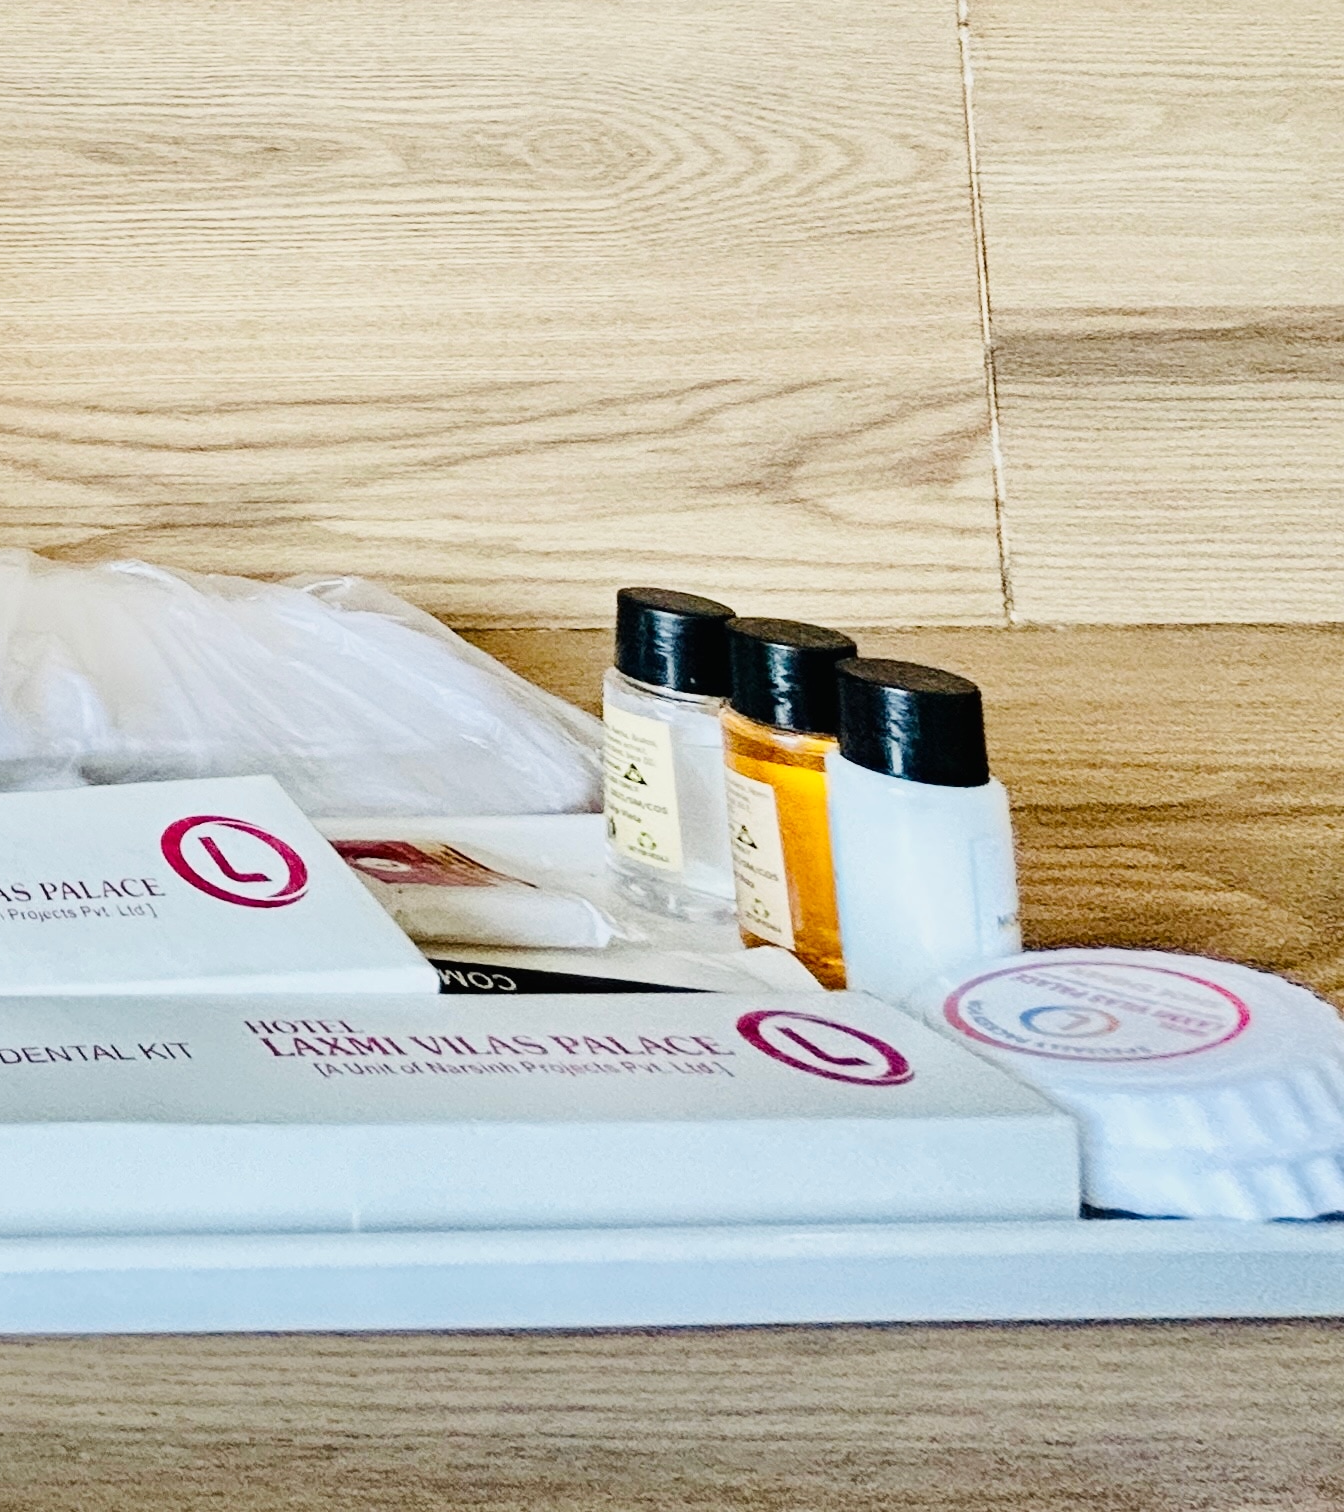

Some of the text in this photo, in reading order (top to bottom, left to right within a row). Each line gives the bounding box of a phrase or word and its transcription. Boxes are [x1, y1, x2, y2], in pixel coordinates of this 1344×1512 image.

[38, 877, 166, 902] PALACE
[11, 906, 78, 923] Projects
[437, 968, 518, 991] COM
[244, 1019, 364, 1035] HOTEL
[139, 1040, 195, 1061] KIT
[261, 1035, 735, 1057] LAXMI VILAS PALACE
[344, 1061, 397, 1076] Unit
[400, 1061, 424, 1076] of
[519, 1060, 623, 1078] Projects
